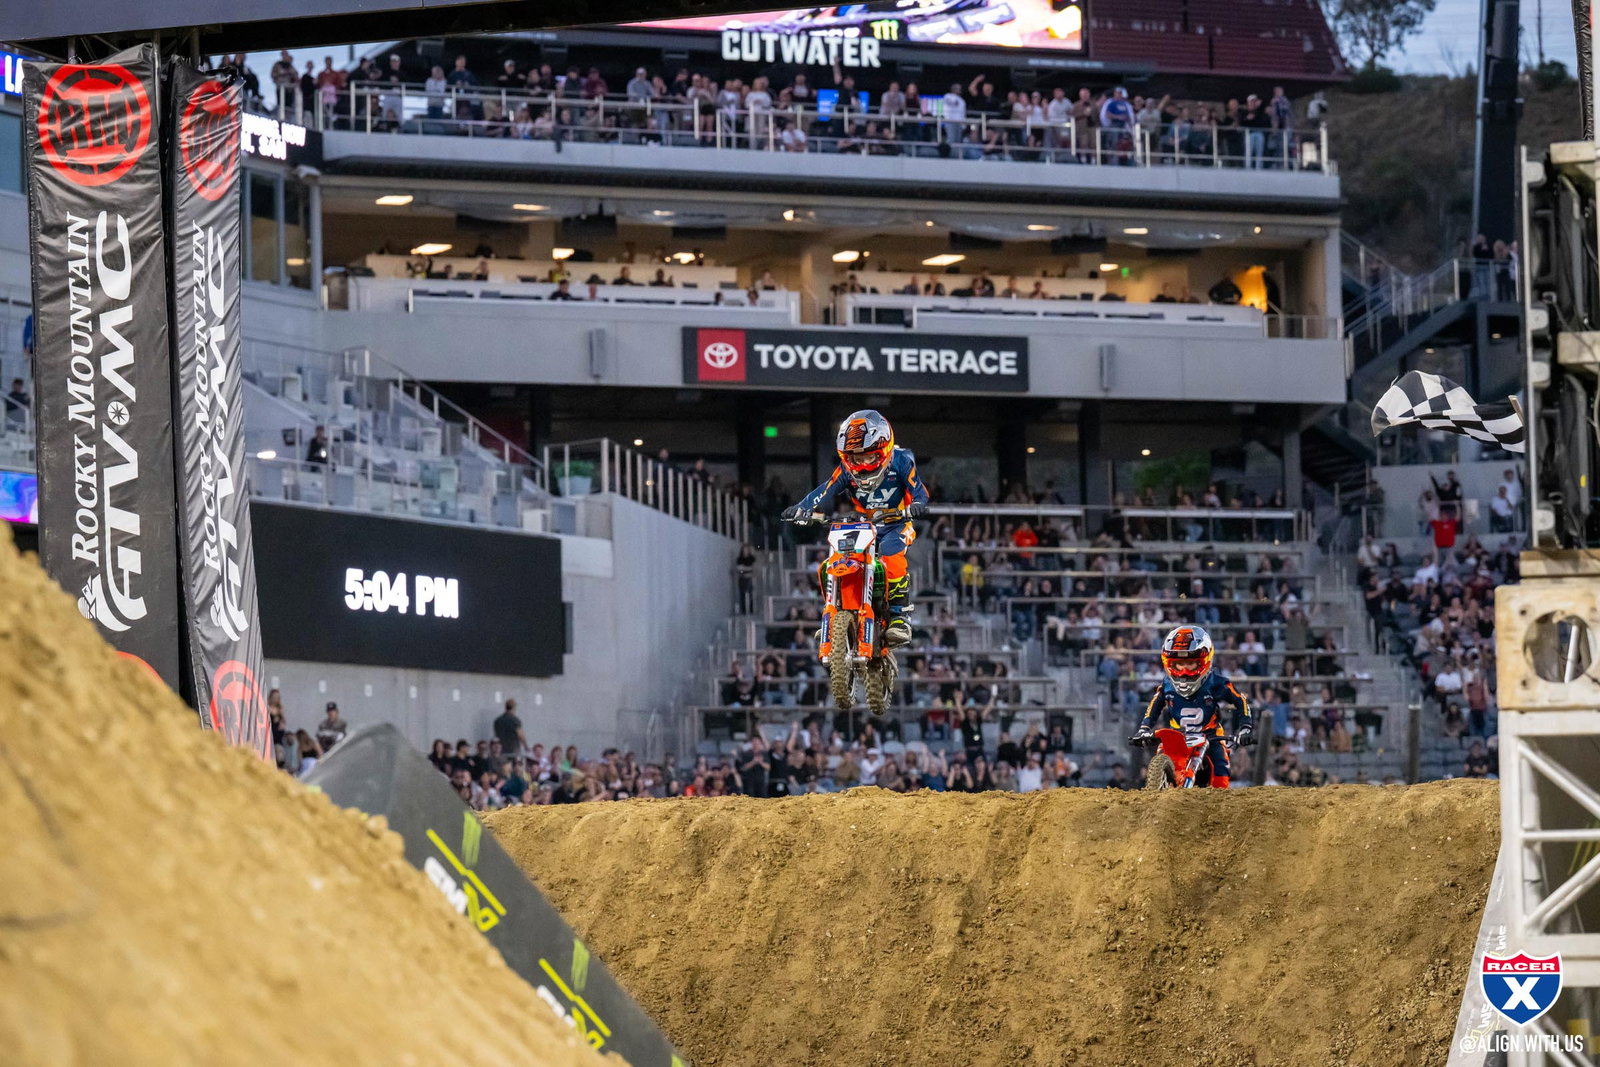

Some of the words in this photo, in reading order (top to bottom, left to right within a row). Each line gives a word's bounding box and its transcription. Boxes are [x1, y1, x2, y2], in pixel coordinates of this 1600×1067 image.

[721, 30, 882, 69] CUTWATER
[67, 212, 96, 429] MOUNTAIN
[754, 344, 874, 372] TOYOTA
[880, 347, 1018, 375] TERRACE
[72, 434, 99, 567] ROCKY
[199, 443, 222, 576] ROCKY
[843, 530, 861, 549] 1
[344, 567, 410, 614] 5:04
[415, 575, 459, 619] PM
[1180, 707, 1204, 732] 2
